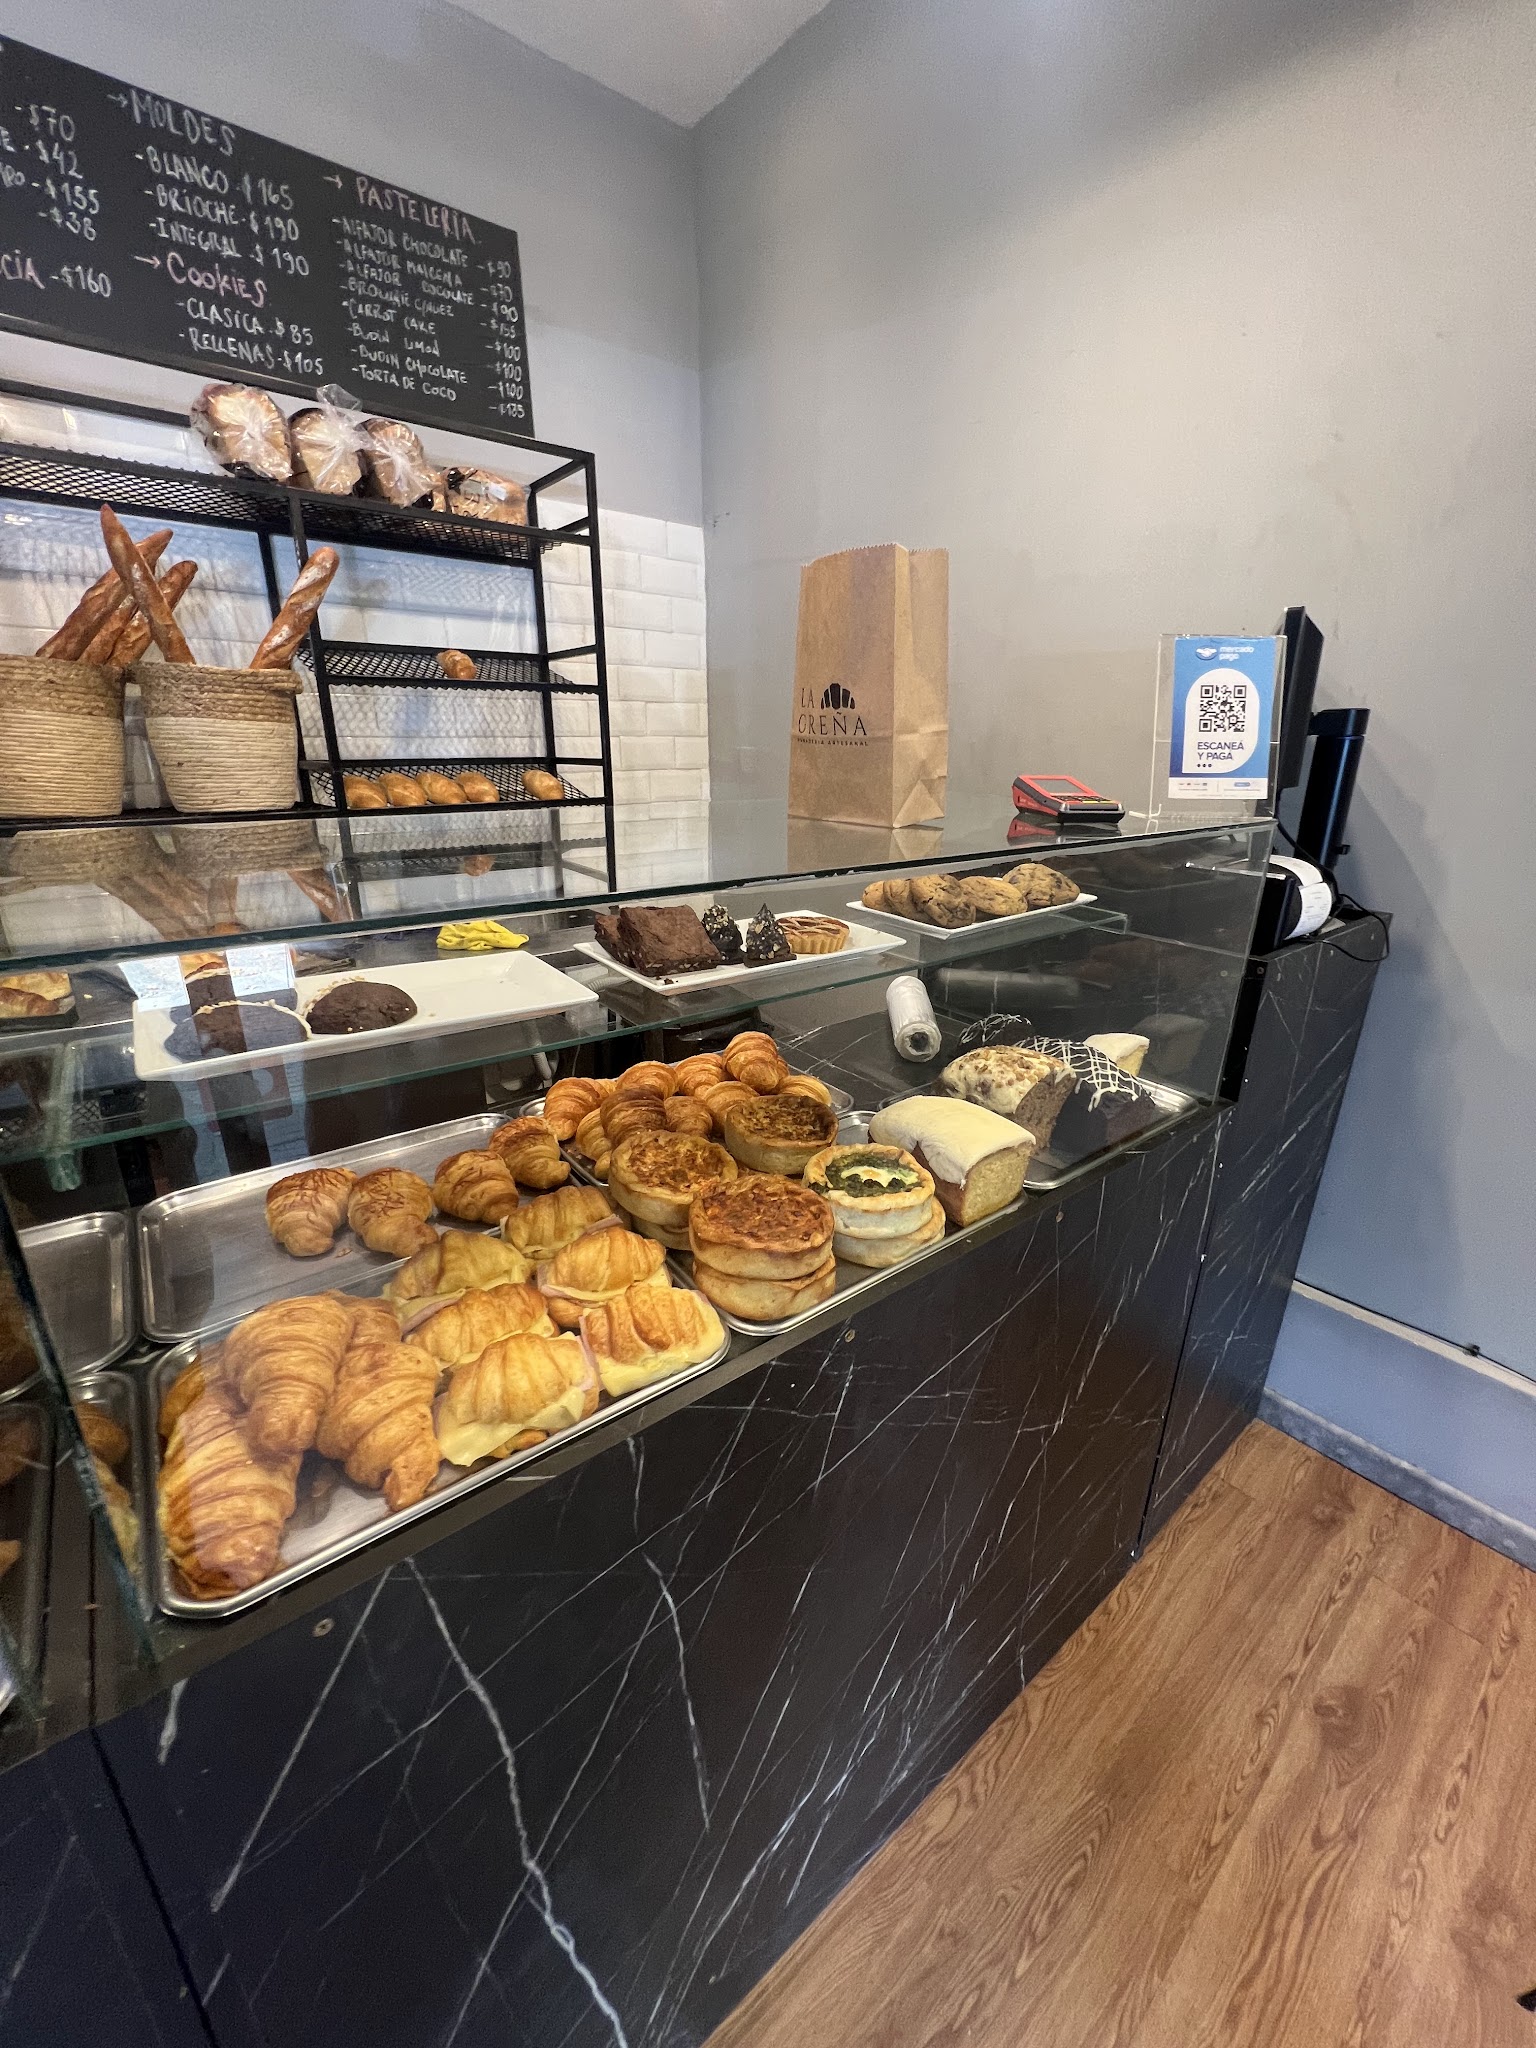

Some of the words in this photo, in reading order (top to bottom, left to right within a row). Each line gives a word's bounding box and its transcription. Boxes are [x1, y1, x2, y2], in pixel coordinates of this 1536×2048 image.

[131, 89, 236, 156] MOLDES
[146, 145, 229, 194] BLANCO
[402, 377, 415, 390] DE
[801, 688, 815, 709] LA
[798, 711, 868, 736] CREÑA
[1197, 752, 1204, 760] Y
